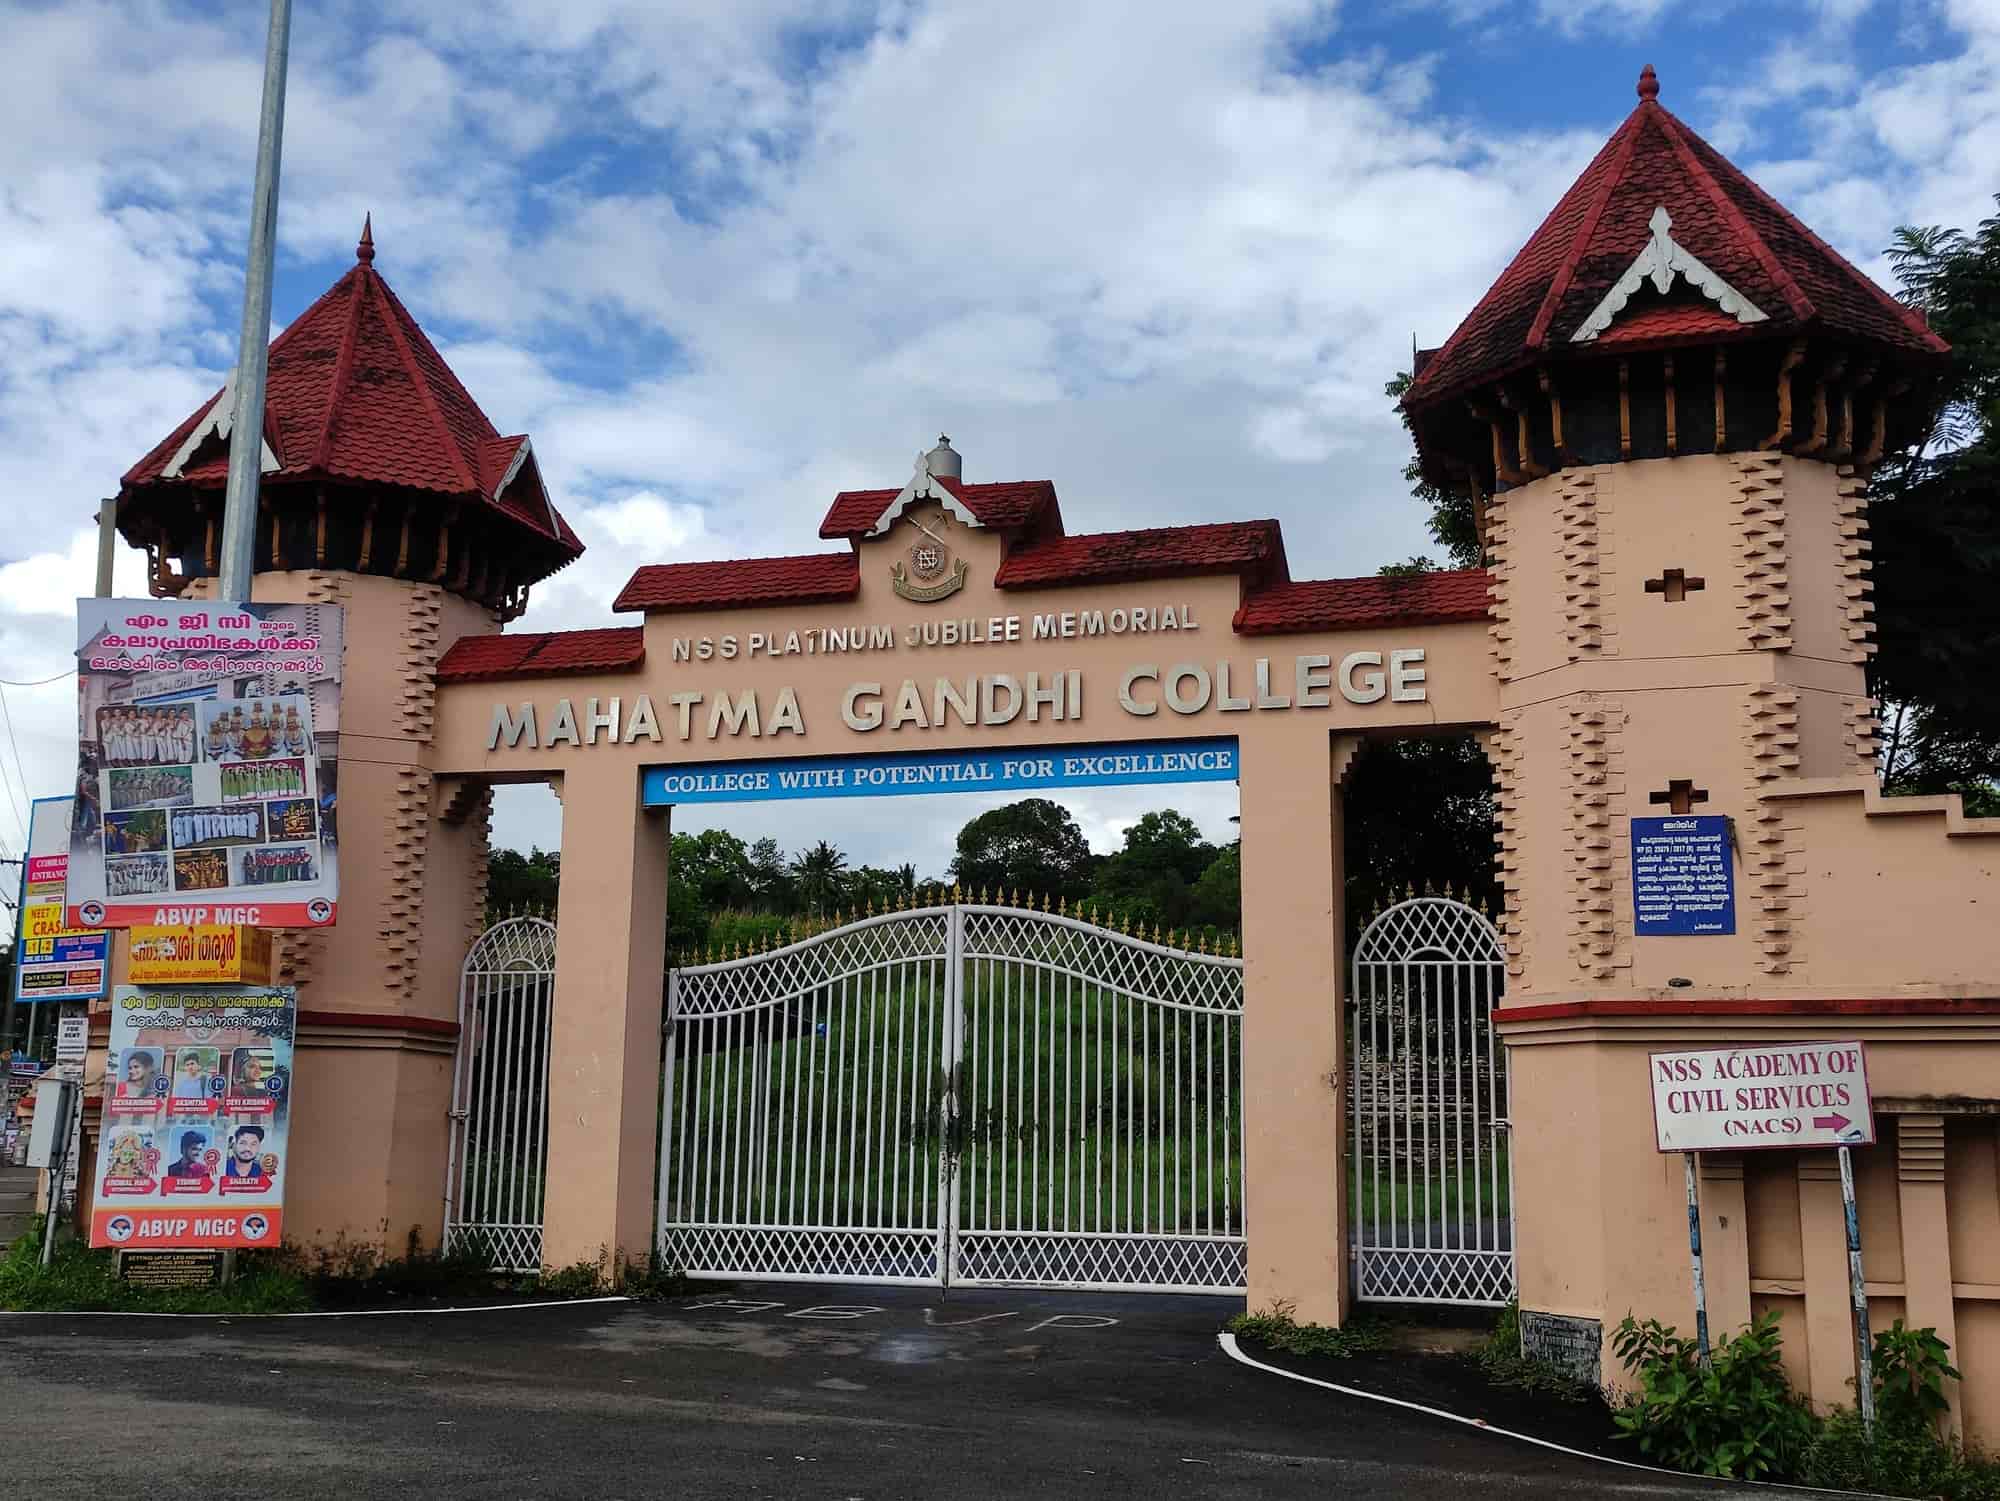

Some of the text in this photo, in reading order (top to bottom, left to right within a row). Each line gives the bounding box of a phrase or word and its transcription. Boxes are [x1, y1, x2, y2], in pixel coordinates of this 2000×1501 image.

[126, 614, 168, 629] എം
[179, 613, 209, 629] ജി
[218, 614, 250, 629] സി
[672, 605, 1200, 662] NSS PLATINUM JUBILEE MEMORIAL
[488, 648, 1427, 751] MAHATMA GANDHI COLLEGE
[664, 751, 1233, 793] COLLEGE WITH POTENTIAL FOR EXCELLENCE
[154, 907, 260, 926] ABVP MGC
[198, 926, 236, 969] തരൂർ
[1658, 1050, 1859, 1082] NSS ACADEMY OF
[1668, 1083, 1850, 1114] CIVIL SERVICES
[1724, 1117, 1802, 1136] (NACS)
[138, 1218, 237, 1237] ABVP MGC
